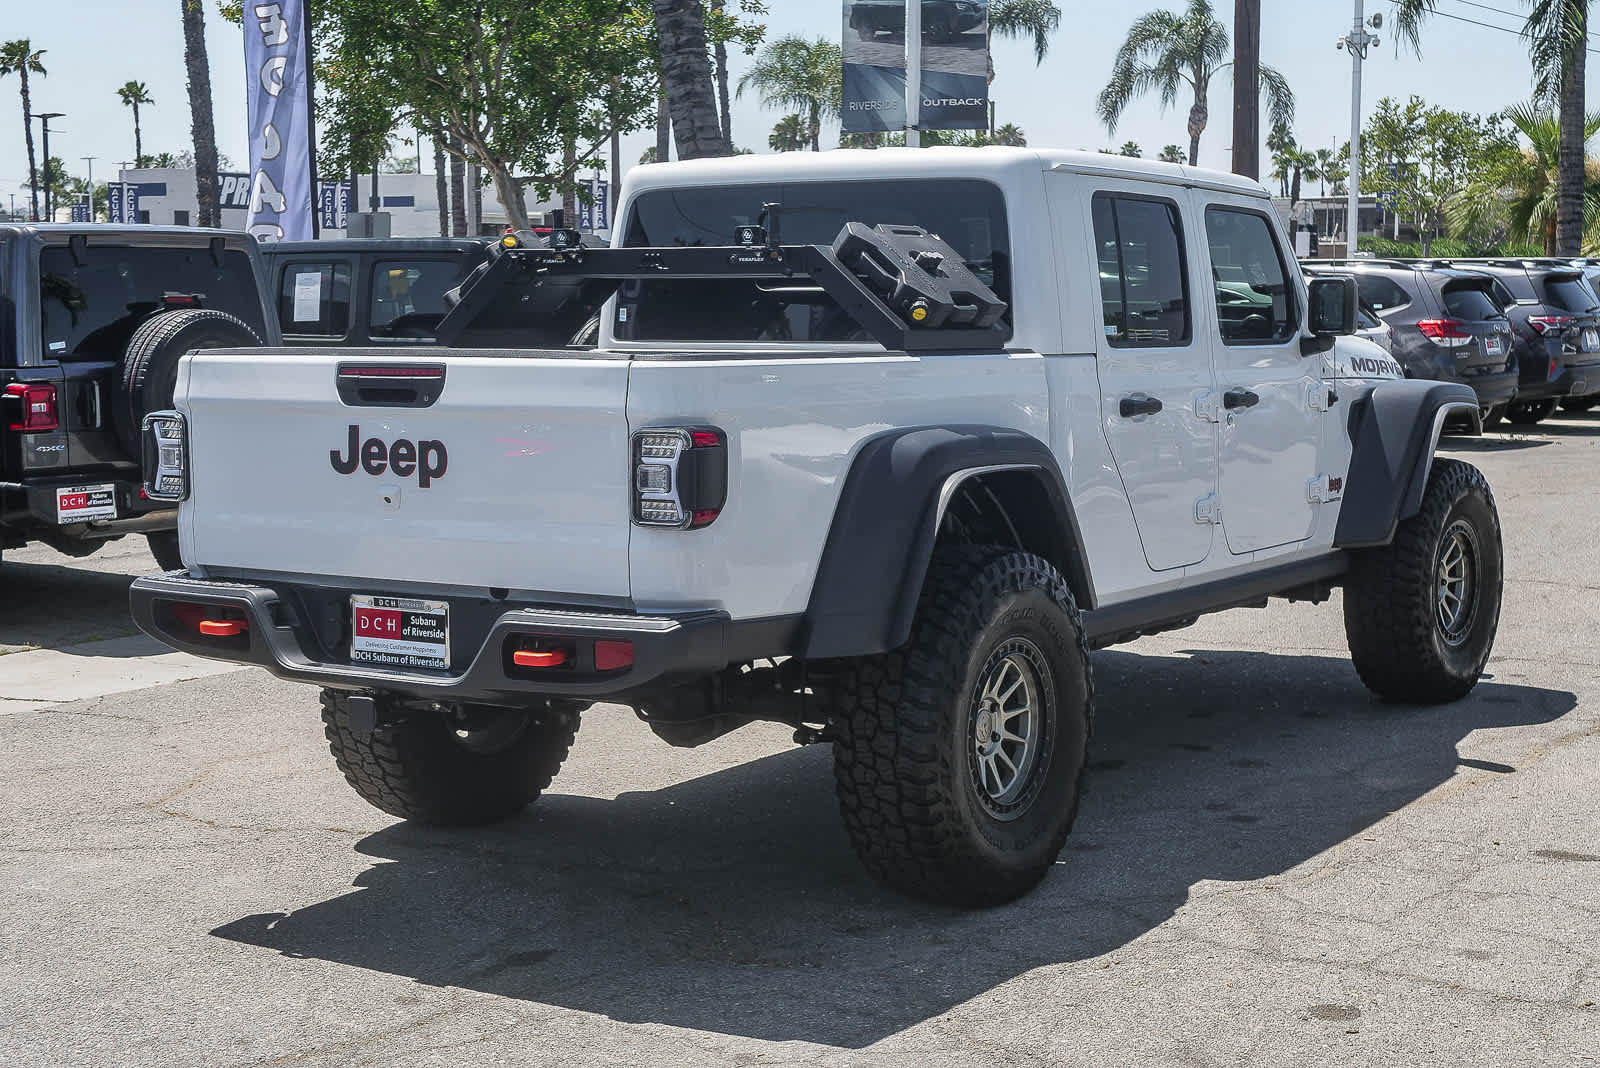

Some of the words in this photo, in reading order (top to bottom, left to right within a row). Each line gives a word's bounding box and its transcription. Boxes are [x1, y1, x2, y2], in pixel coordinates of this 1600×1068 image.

[848, 101, 897, 111] RIVERSIDE
[922, 98, 983, 106] OUTBACK
[324, 190, 333, 227] ACURA
[339, 190, 348, 227] ACURA
[329, 423, 449, 489] Jeep
[62, 497, 84, 507] DCH
[361, 616, 396, 632] DCH
[410, 616, 437, 627] Subaru
[402, 627, 411, 636] of
[411, 628, 445, 639] Riverside
[365, 641, 389, 650] Delivering
[389, 643, 412, 652] Customer
[412, 646, 437, 654] Happiness
[355, 651, 371, 661] DCH
[372, 653, 399, 664] Subaru
[400, 656, 409, 665] of
[409, 656, 444, 668] Riverside
